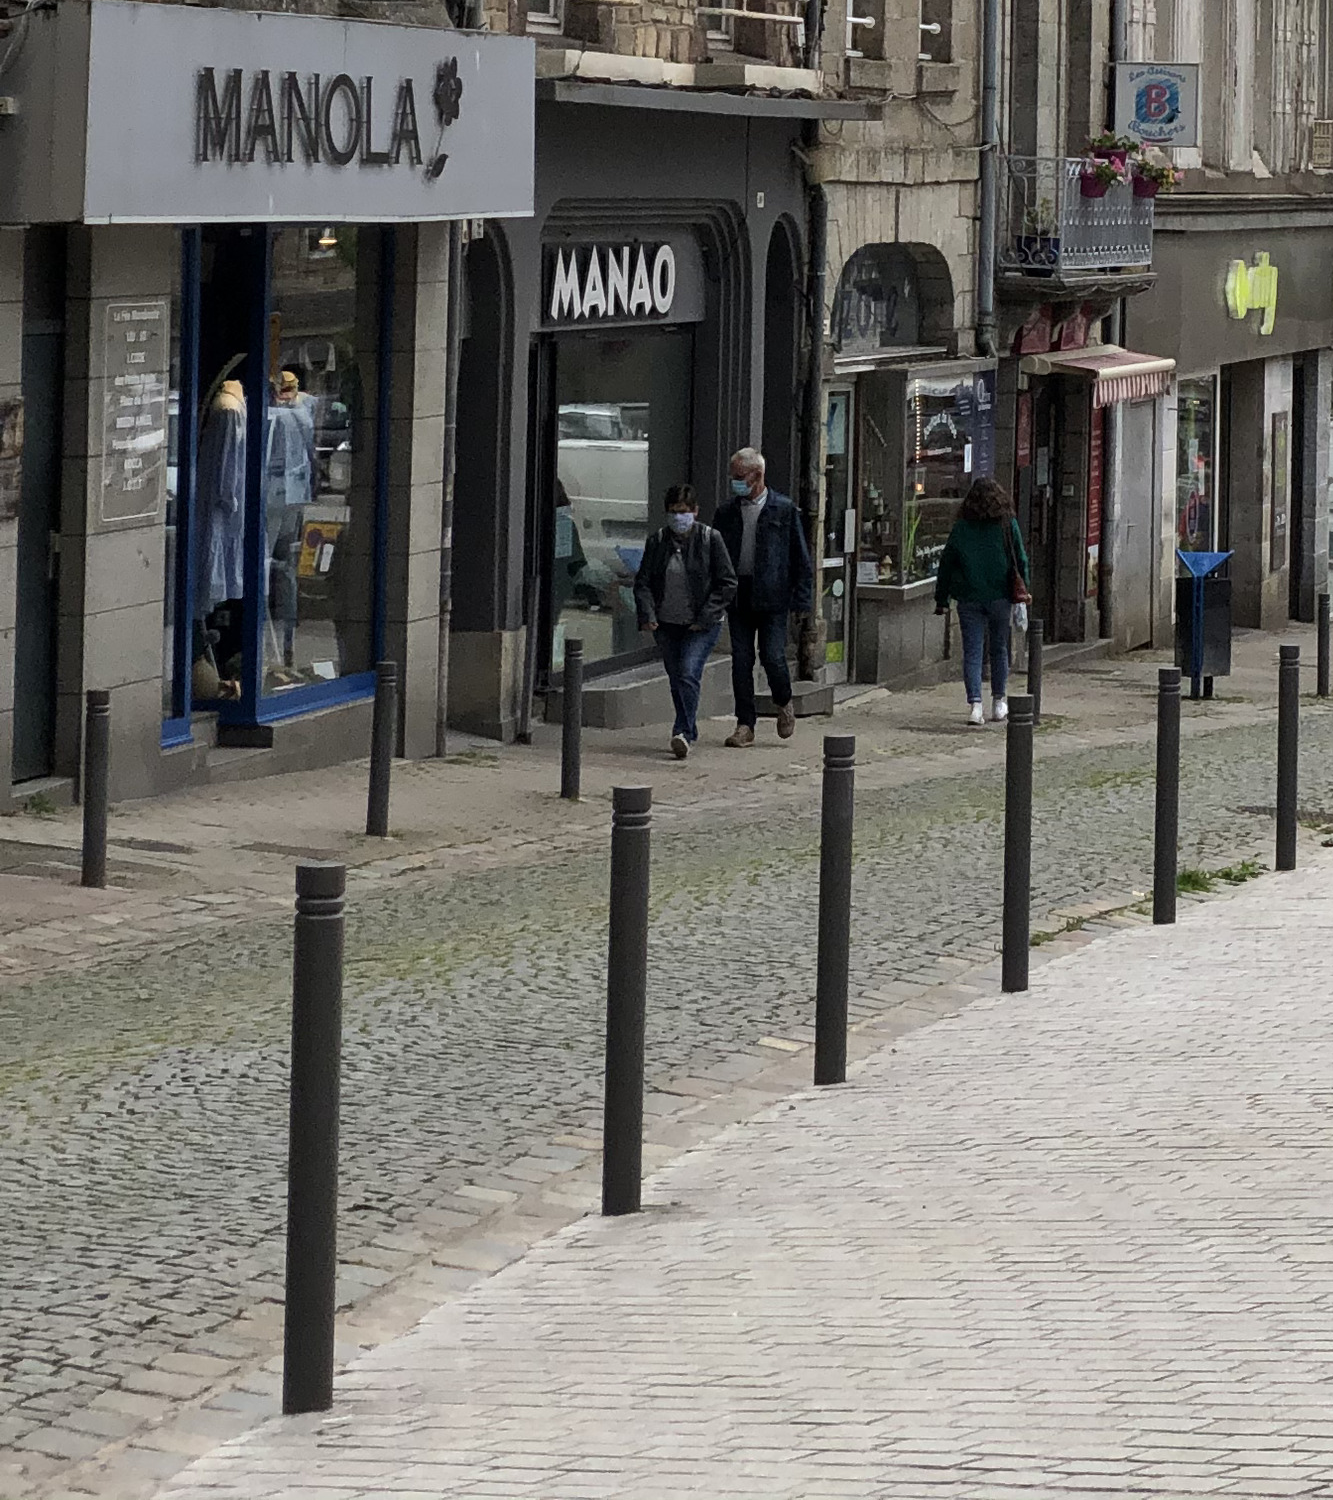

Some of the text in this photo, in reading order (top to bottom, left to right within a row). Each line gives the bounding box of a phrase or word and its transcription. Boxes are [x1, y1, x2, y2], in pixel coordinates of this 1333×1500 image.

[196, 66, 424, 167] MANOLA
[1127, 120, 1186, 137] Bouchers
[1144, 83, 1169, 118] B
[551, 243, 677, 321] MANAO
